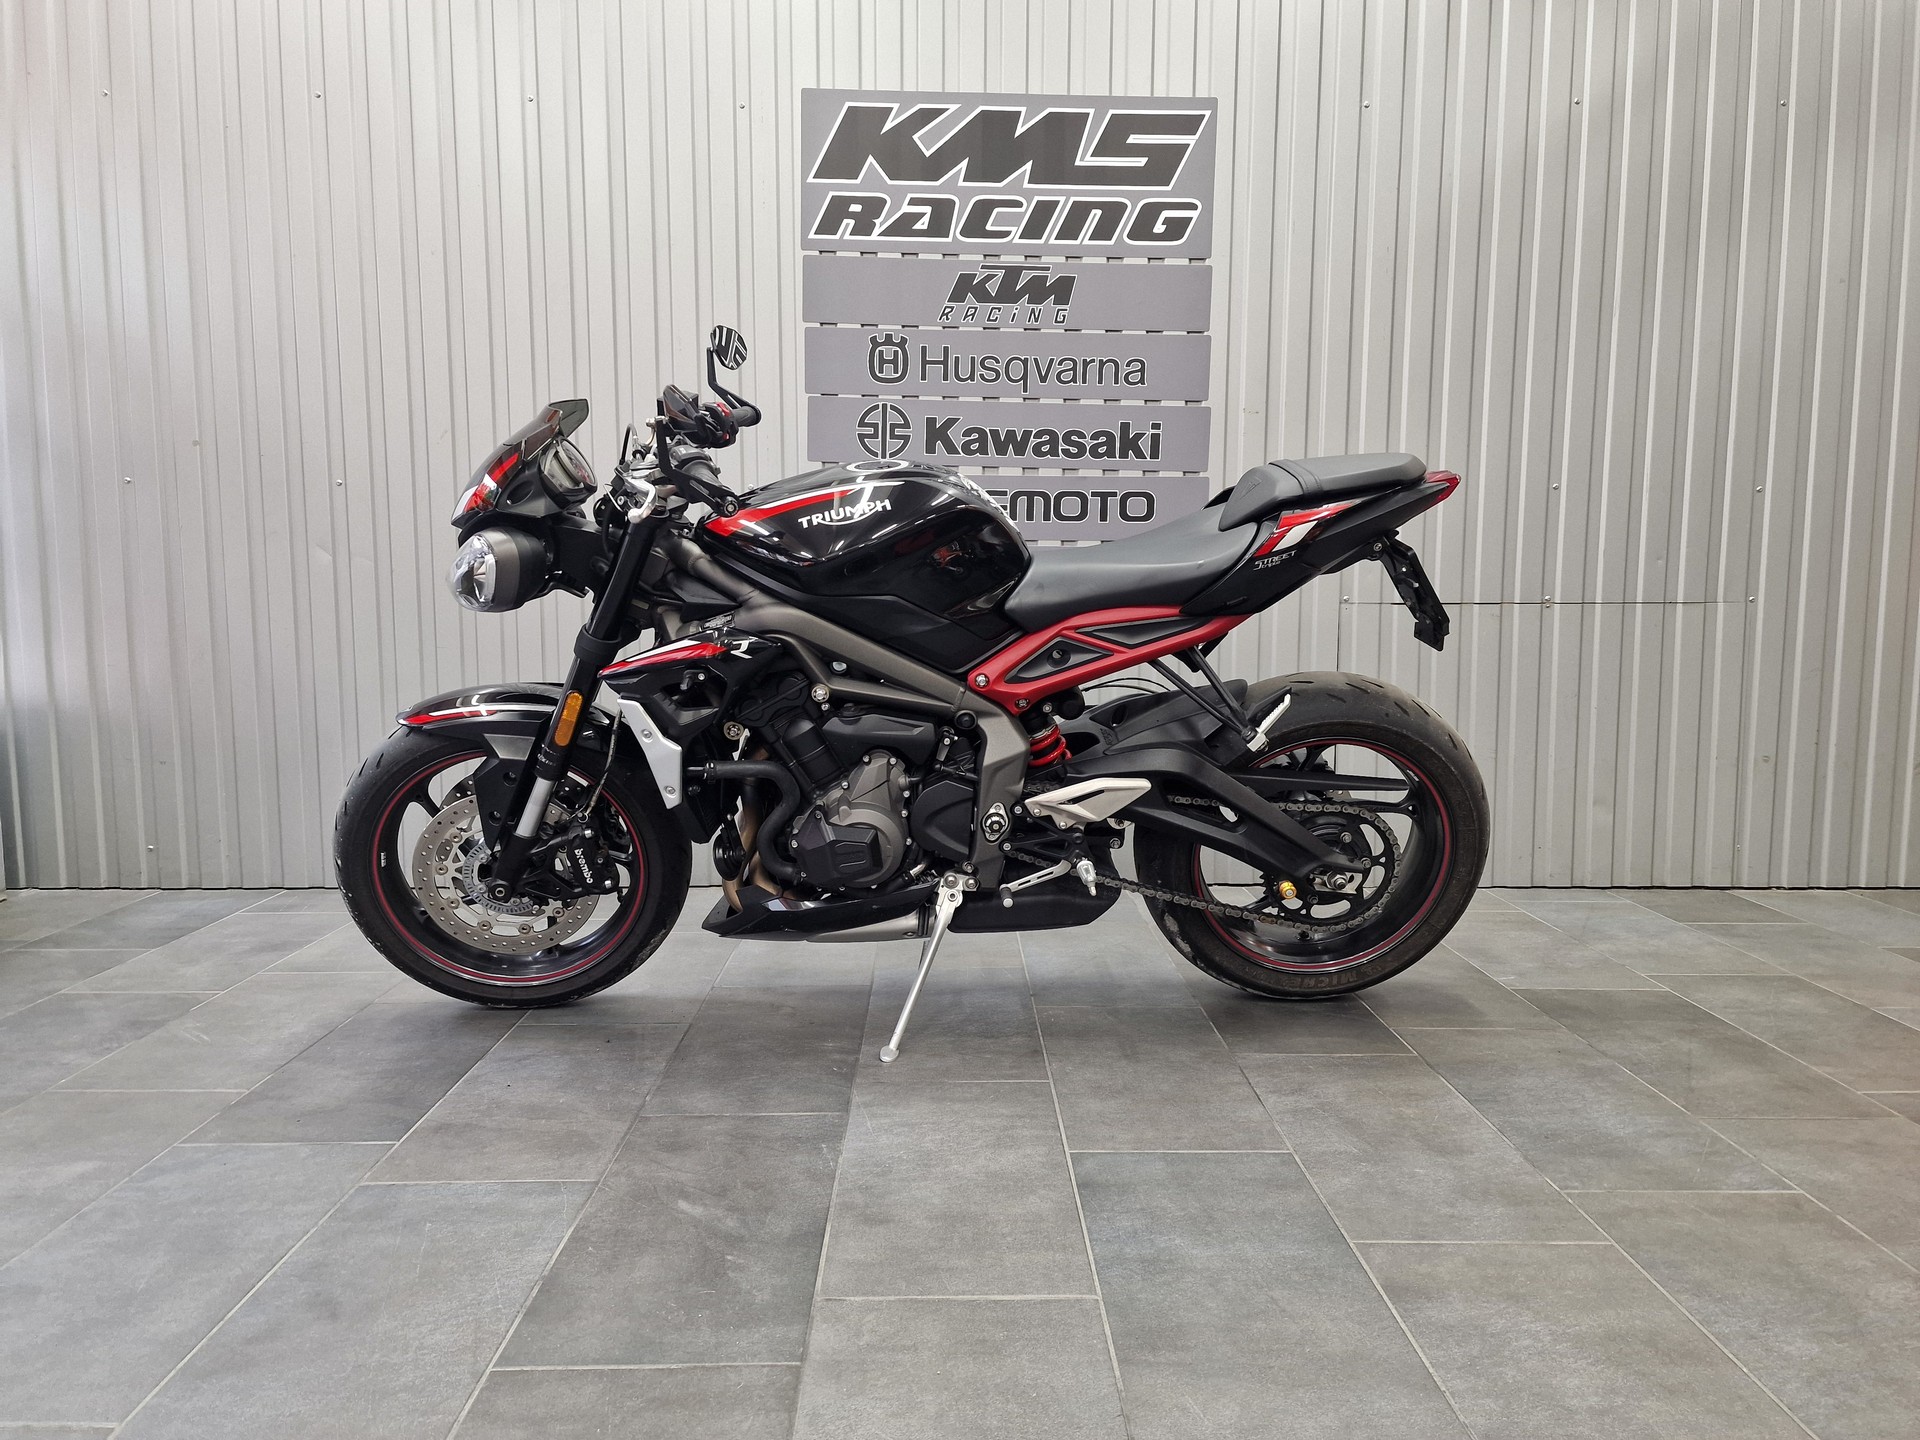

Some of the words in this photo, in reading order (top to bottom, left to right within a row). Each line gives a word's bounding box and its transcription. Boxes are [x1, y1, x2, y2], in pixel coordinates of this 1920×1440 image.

[806, 101, 1212, 190] KMS
[808, 191, 1202, 245] RACING
[945, 264, 1078, 306] KTM
[919, 344, 1148, 394] Husqvarna
[924, 416, 1162, 460] Kawasaki
[798, 499, 892, 529] TRIUMPH
[1253, 549, 1297, 571] STREET
[574, 848, 594, 884] brembo
